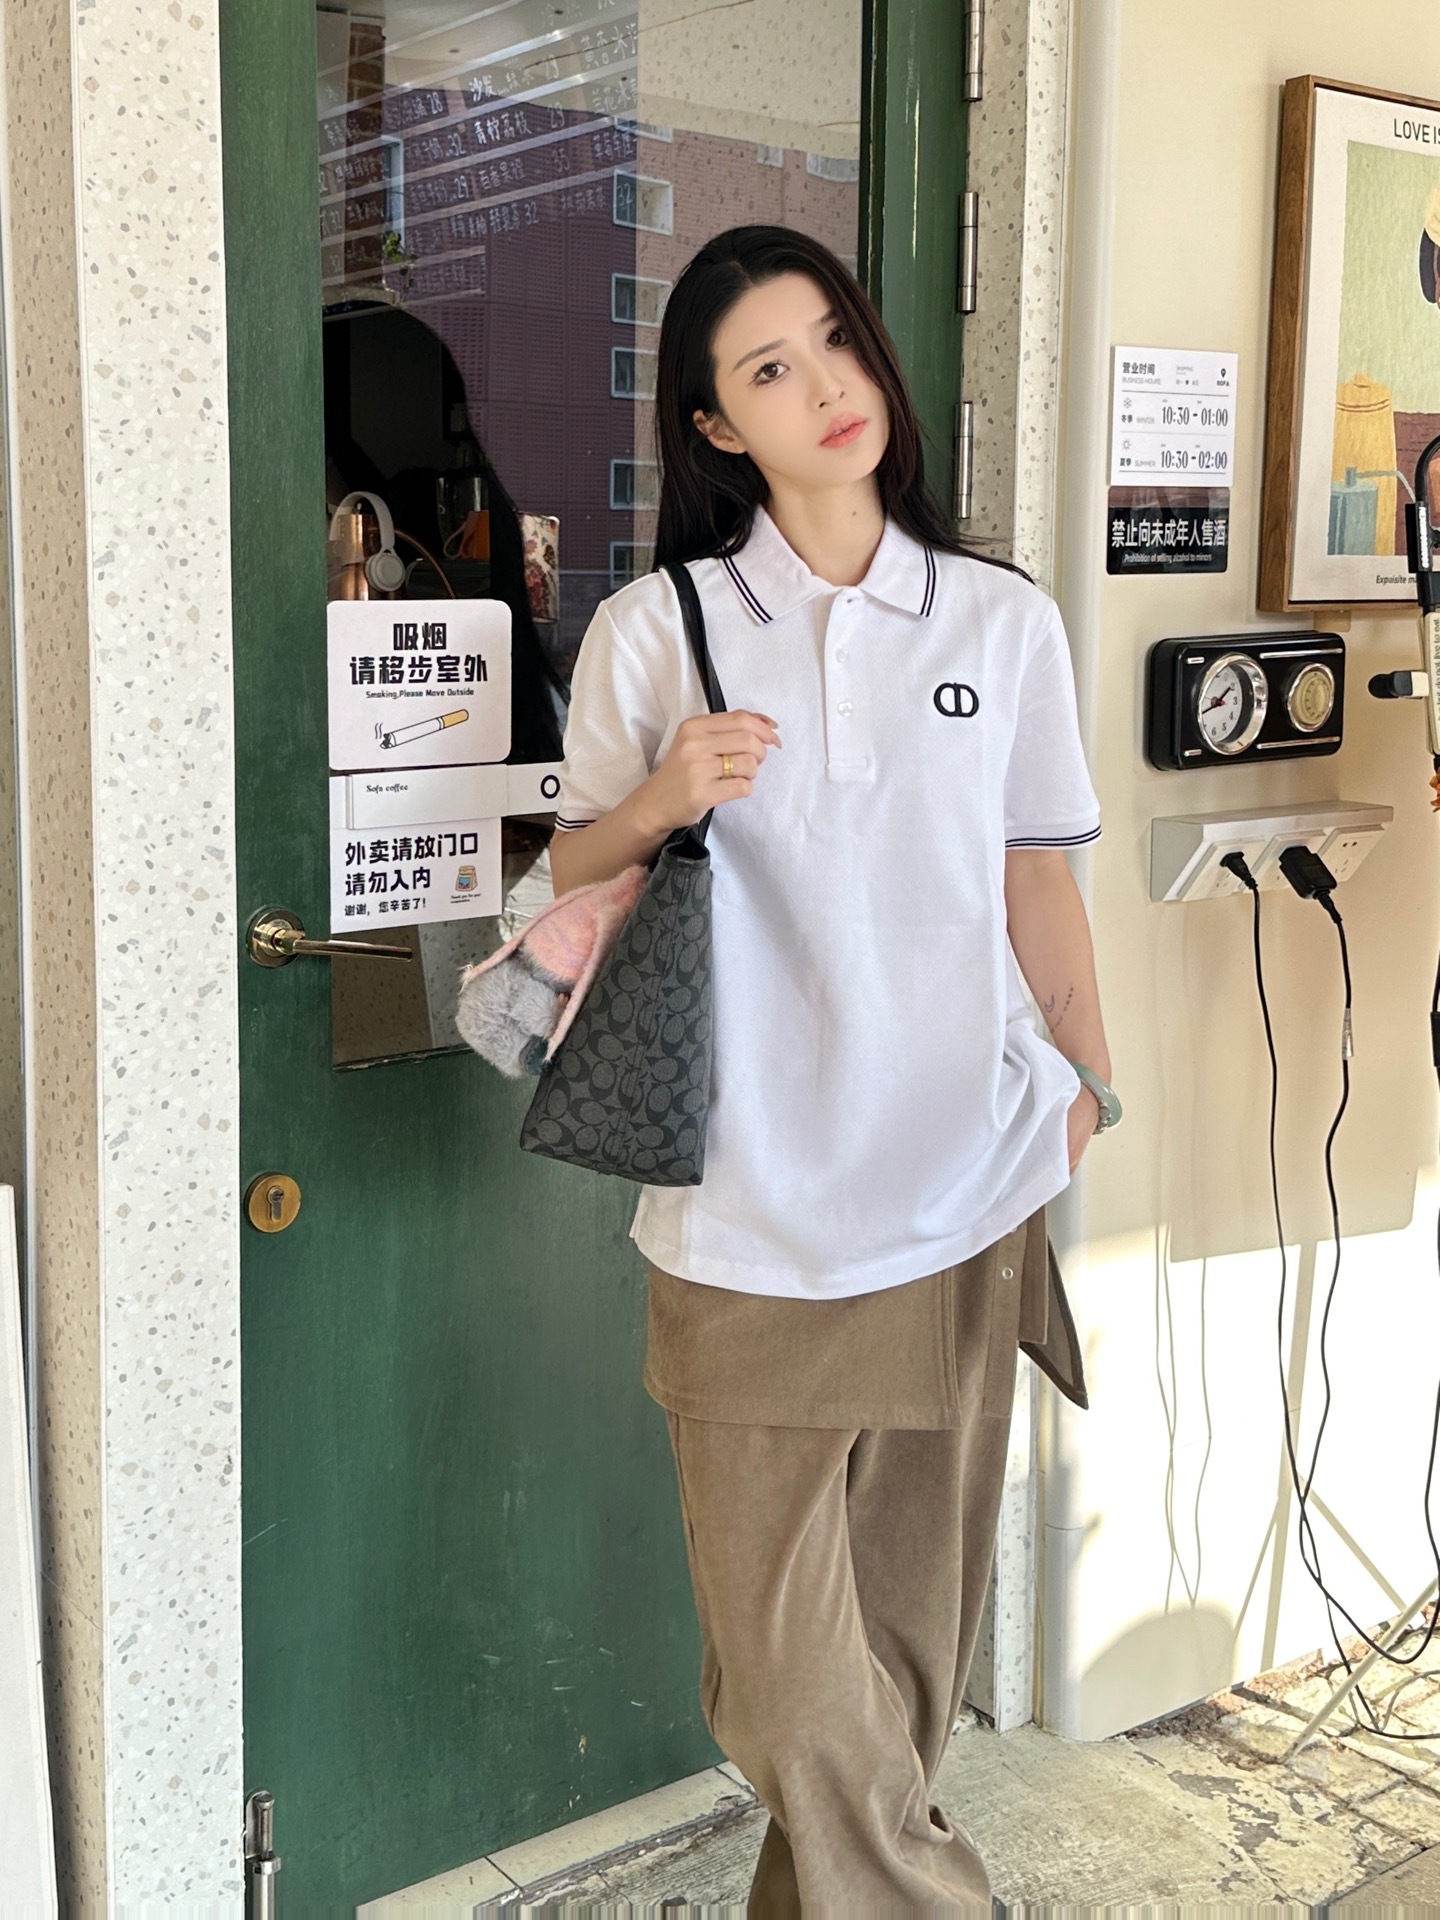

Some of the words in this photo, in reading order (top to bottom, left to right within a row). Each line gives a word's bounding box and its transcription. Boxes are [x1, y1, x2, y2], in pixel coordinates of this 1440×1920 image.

[1394, 118, 1430, 143] LOVE
[1122, 362, 1156, 375] 营业时间
[1162, 406, 1190, 425] 10:30
[1201, 408, 1228, 427] 01:00
[1160, 450, 1188, 469] 10:30
[1198, 450, 1228, 470] 02:00
[1111, 518, 1227, 548] 禁止向未成年人售酒
[393, 622, 447, 650] 吸烟
[350, 654, 488, 685] 请移步室外
[426, 689, 445, 697] Move
[447, 687, 475, 696] Outside
[366, 784, 384, 794] Sofa
[385, 783, 409, 793] coffee
[345, 832, 478, 867] 外卖请放门口
[345, 866, 431, 897] 请勿入内
